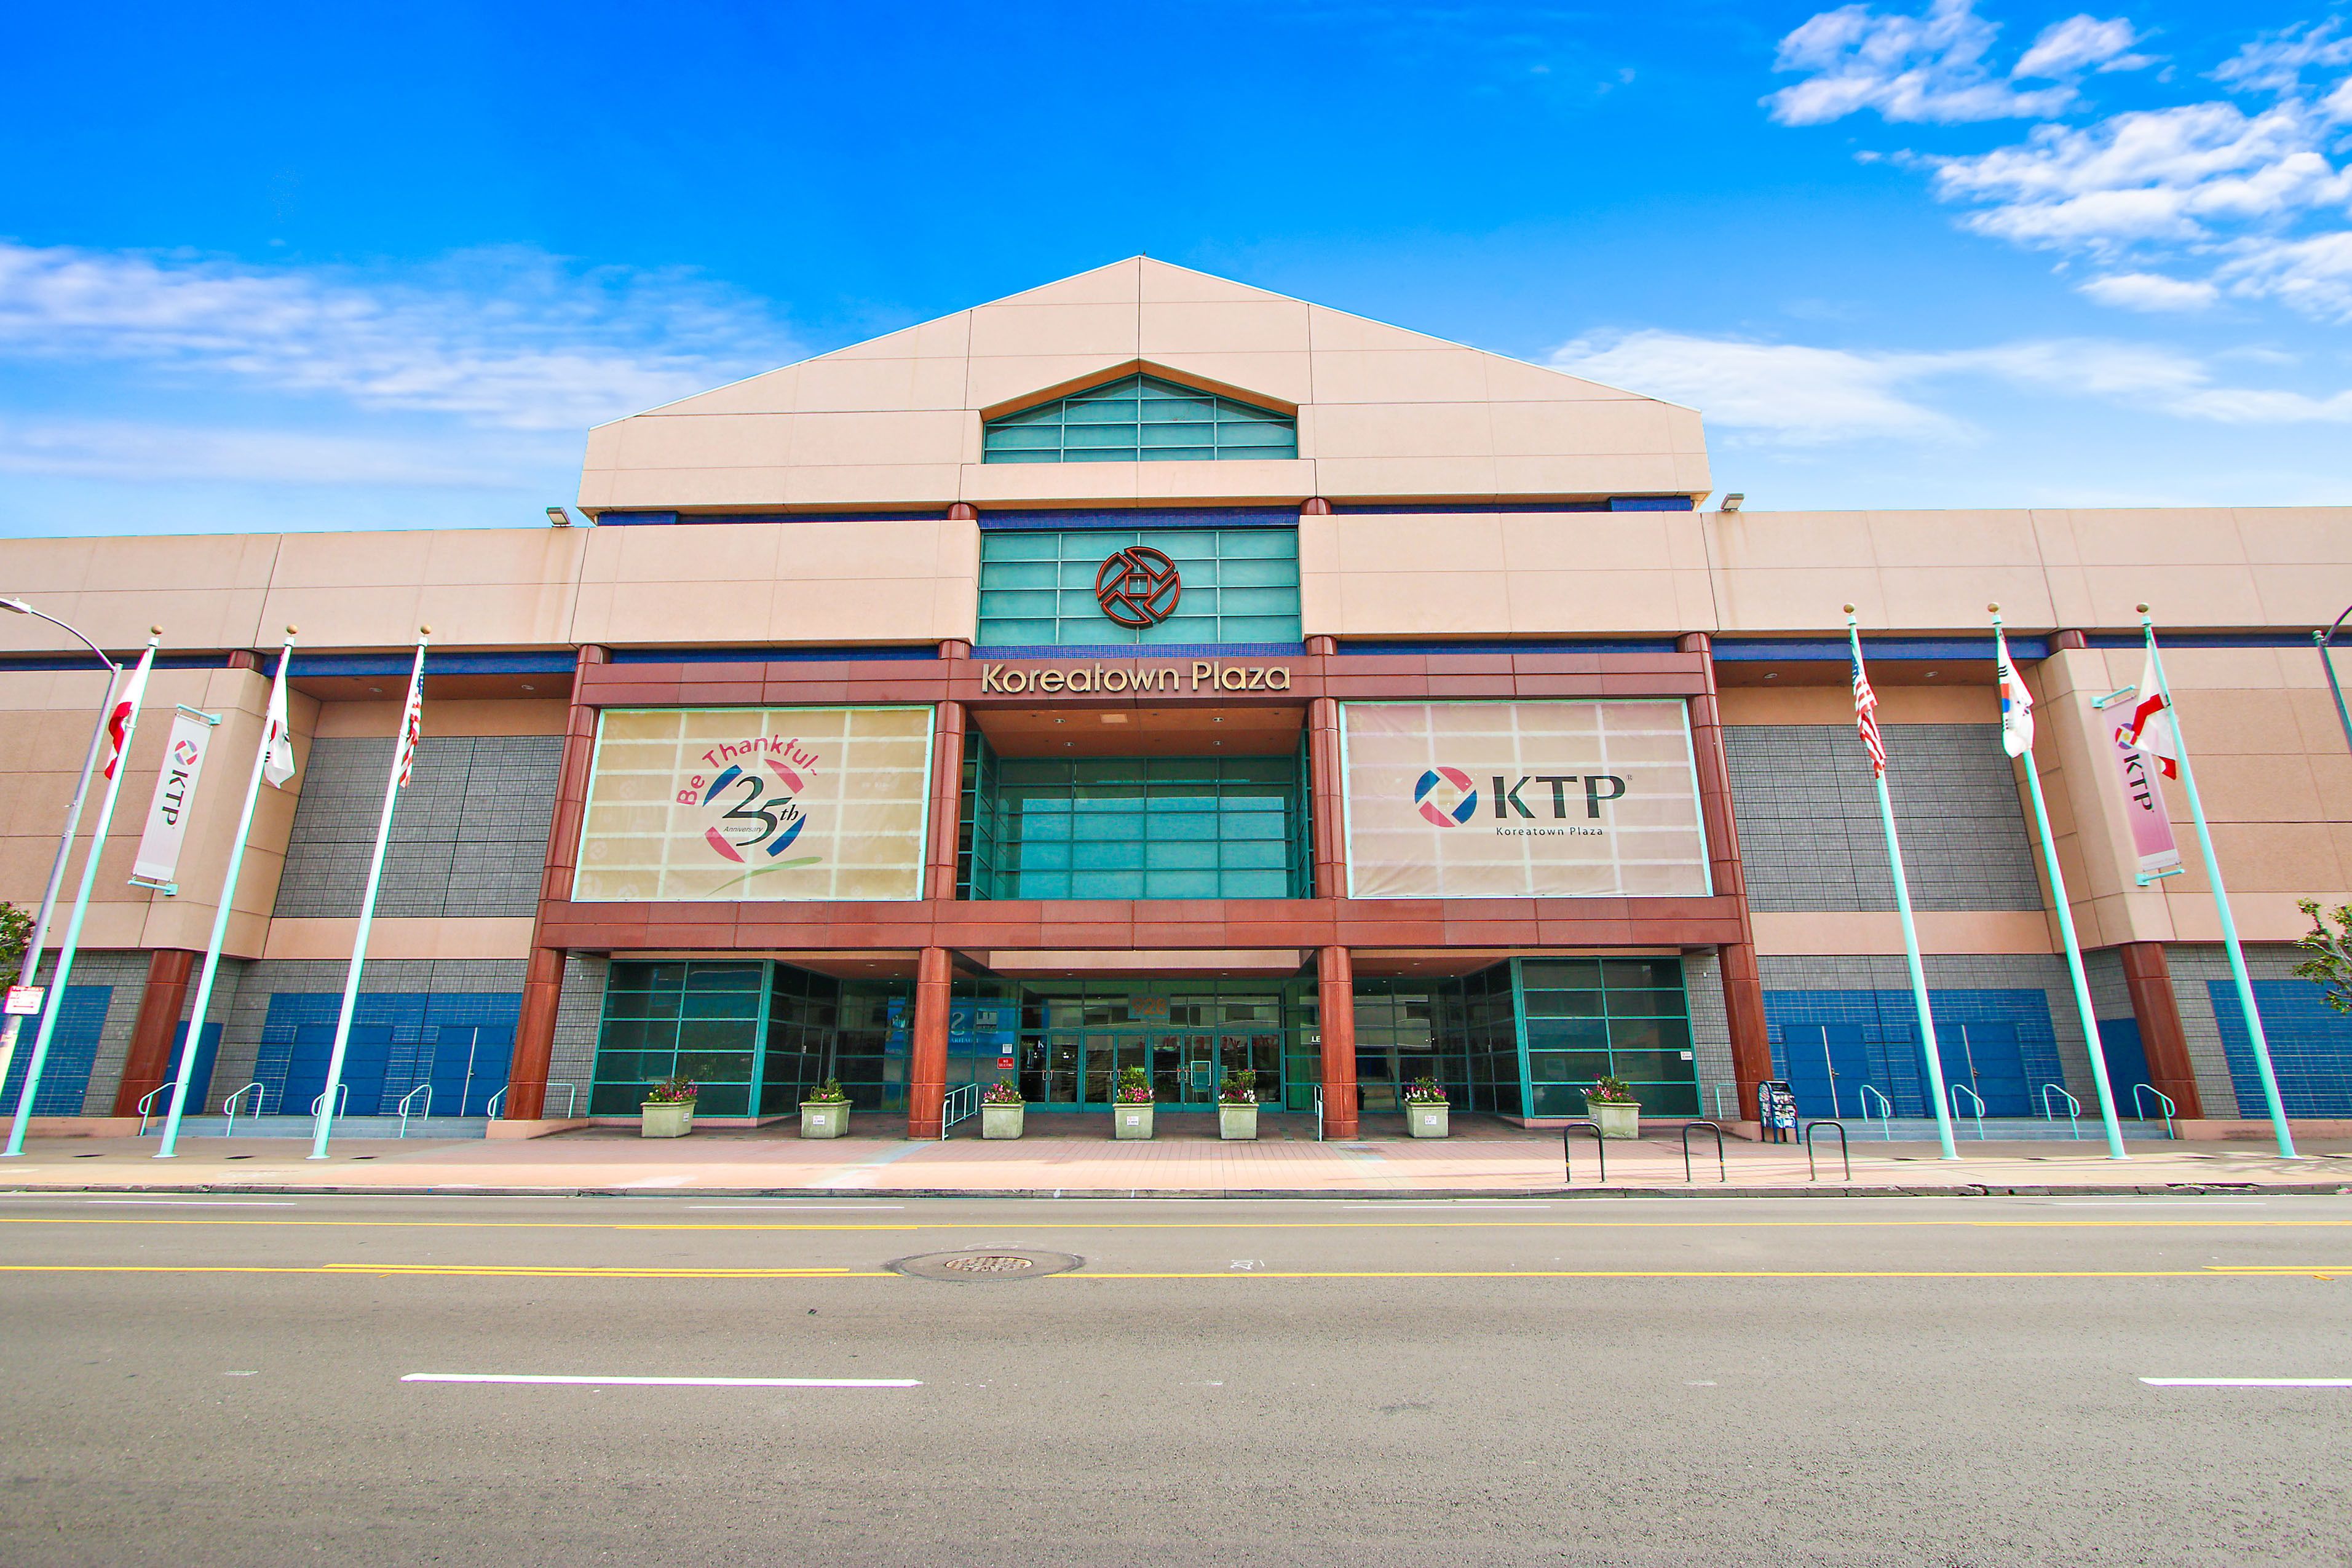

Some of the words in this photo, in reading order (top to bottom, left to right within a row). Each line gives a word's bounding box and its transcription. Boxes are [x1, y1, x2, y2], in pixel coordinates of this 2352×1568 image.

[981, 662, 1180, 693] Koreatown
[1191, 660, 1291, 691] Plaza
[161, 769, 189, 826] KTP
[676, 775, 705, 806] Be
[1491, 775, 1626, 819] KTP
[2123, 753, 2153, 811] KTP
[1496, 826, 1564, 836] Koreatown
[1569, 826, 1604, 836] Plaza
[1131, 997, 1166, 1015] 928
